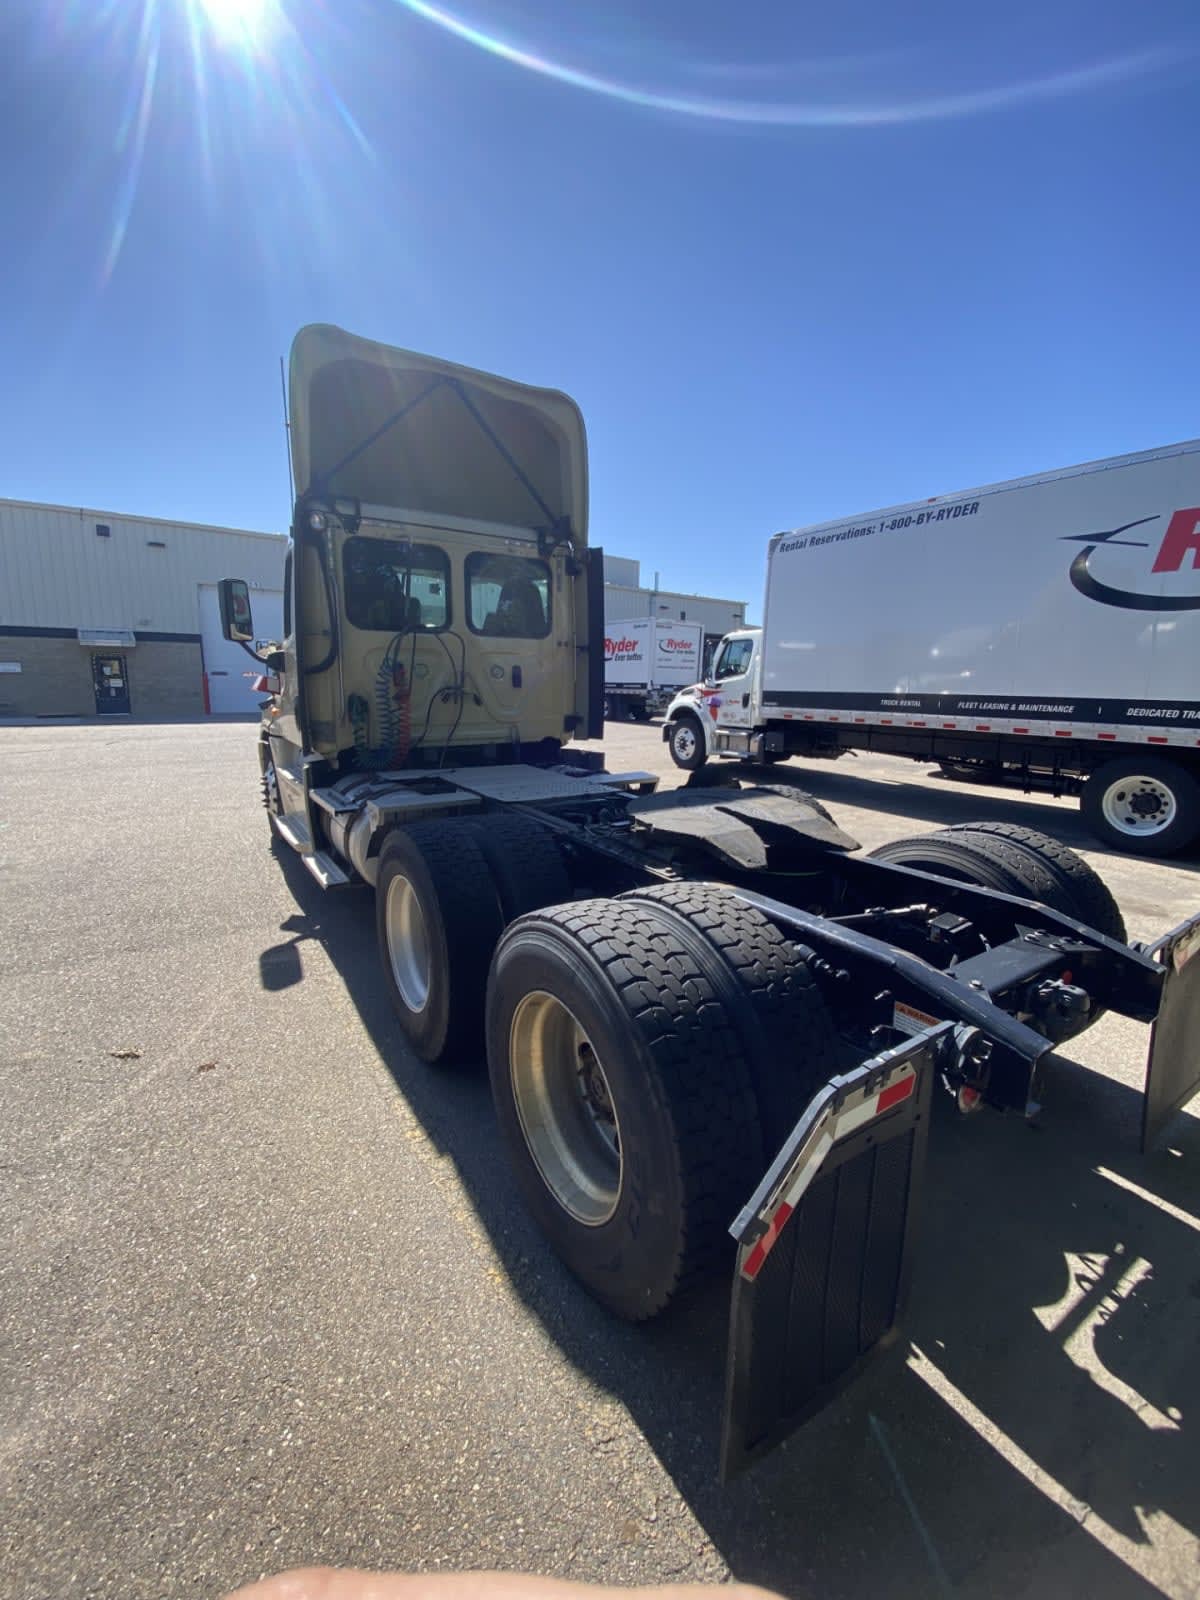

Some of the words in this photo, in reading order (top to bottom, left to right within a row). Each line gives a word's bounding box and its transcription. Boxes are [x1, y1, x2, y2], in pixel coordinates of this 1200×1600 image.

[779, 538, 808, 553] Rental
[808, 525, 876, 547] Reservations:
[879, 502, 980, 532] 1-800-BY-RYDER
[602, 636, 638, 656] Ryder
[666, 638, 693, 650] Ryder
[957, 701, 978, 709] FLEET
[979, 701, 1009, 710] LEASING
[1018, 703, 1075, 713] MAINTENANCE
[1126, 707, 1180, 718] DEDICATED
